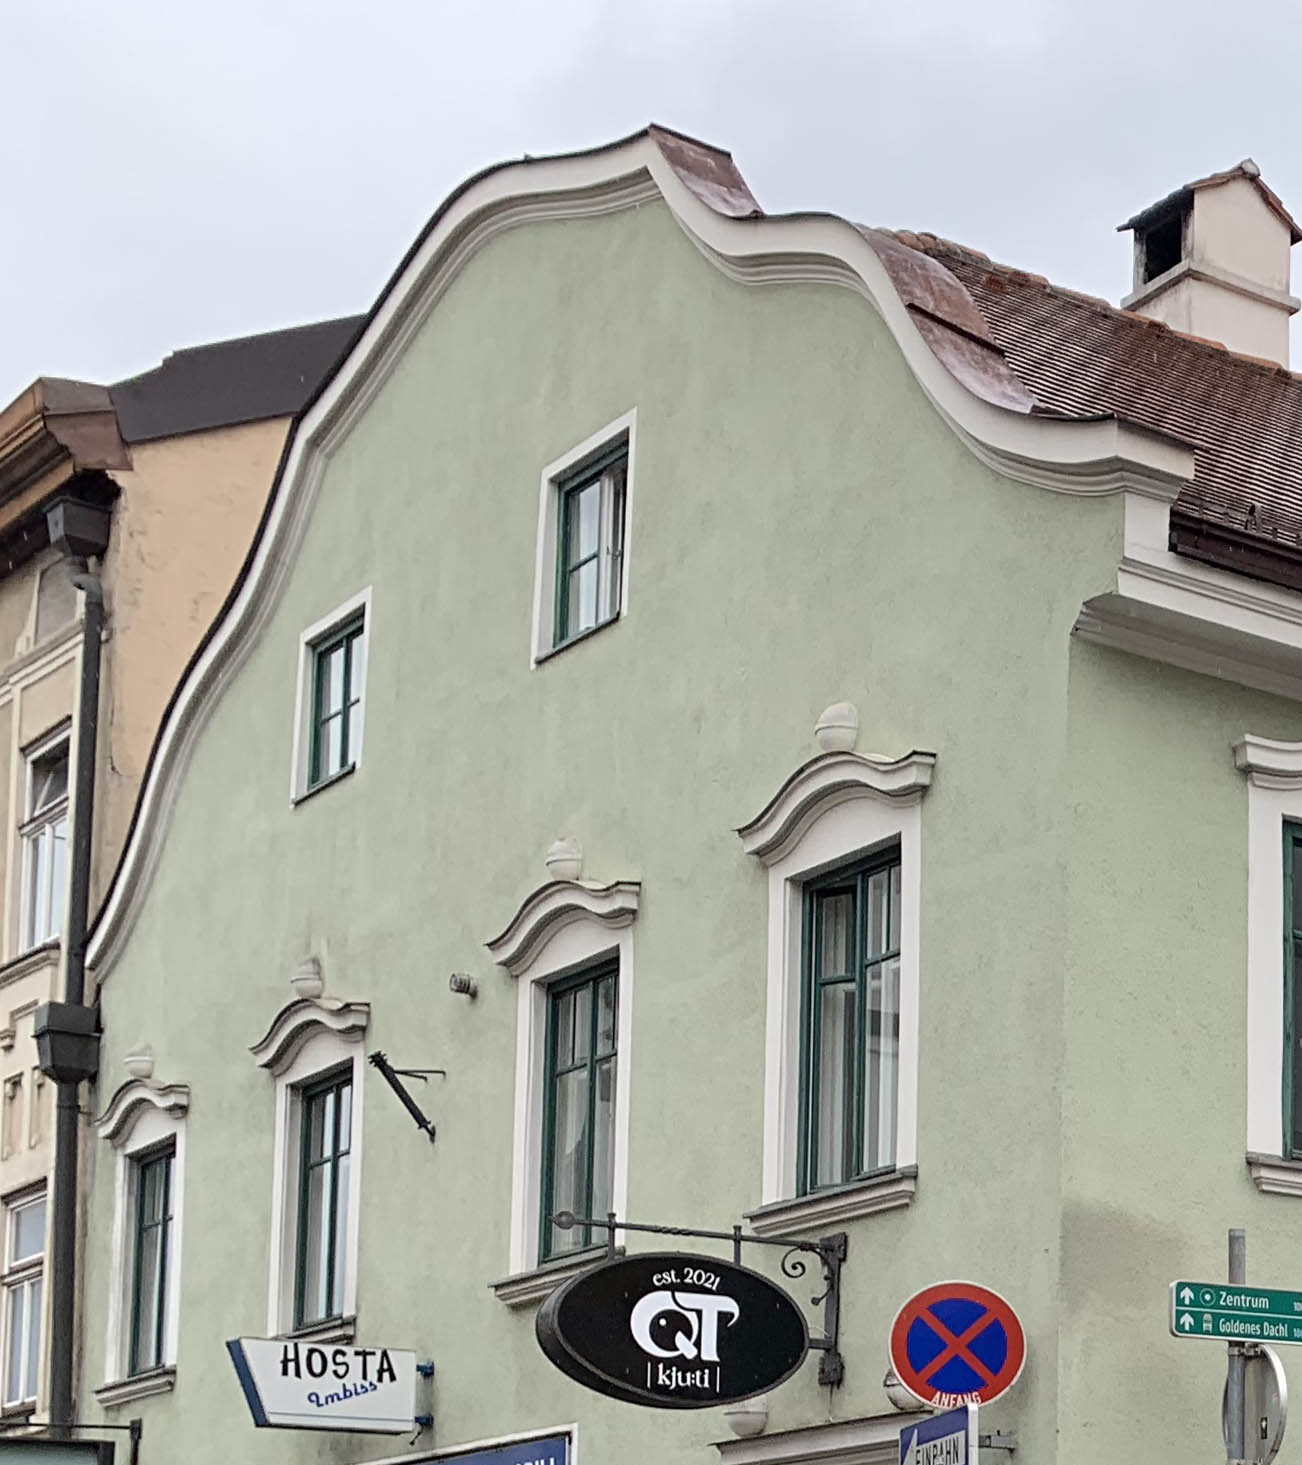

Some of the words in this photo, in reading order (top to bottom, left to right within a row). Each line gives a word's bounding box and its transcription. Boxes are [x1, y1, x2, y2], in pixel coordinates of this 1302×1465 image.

[652, 1270, 680, 1287] est.
[683, 1267, 721, 1291] 2021
[1219, 1291, 1270, 1310] Zentrum
[630, 1290, 740, 1363] QT
[1219, 1317, 1261, 1336] Goldenes
[1263, 1321, 1289, 1338] Dachl
[279, 1342, 398, 1384] HOSTA
[307, 1380, 379, 1408] Imbiss
[930, 1391, 982, 1409] ANFANG
